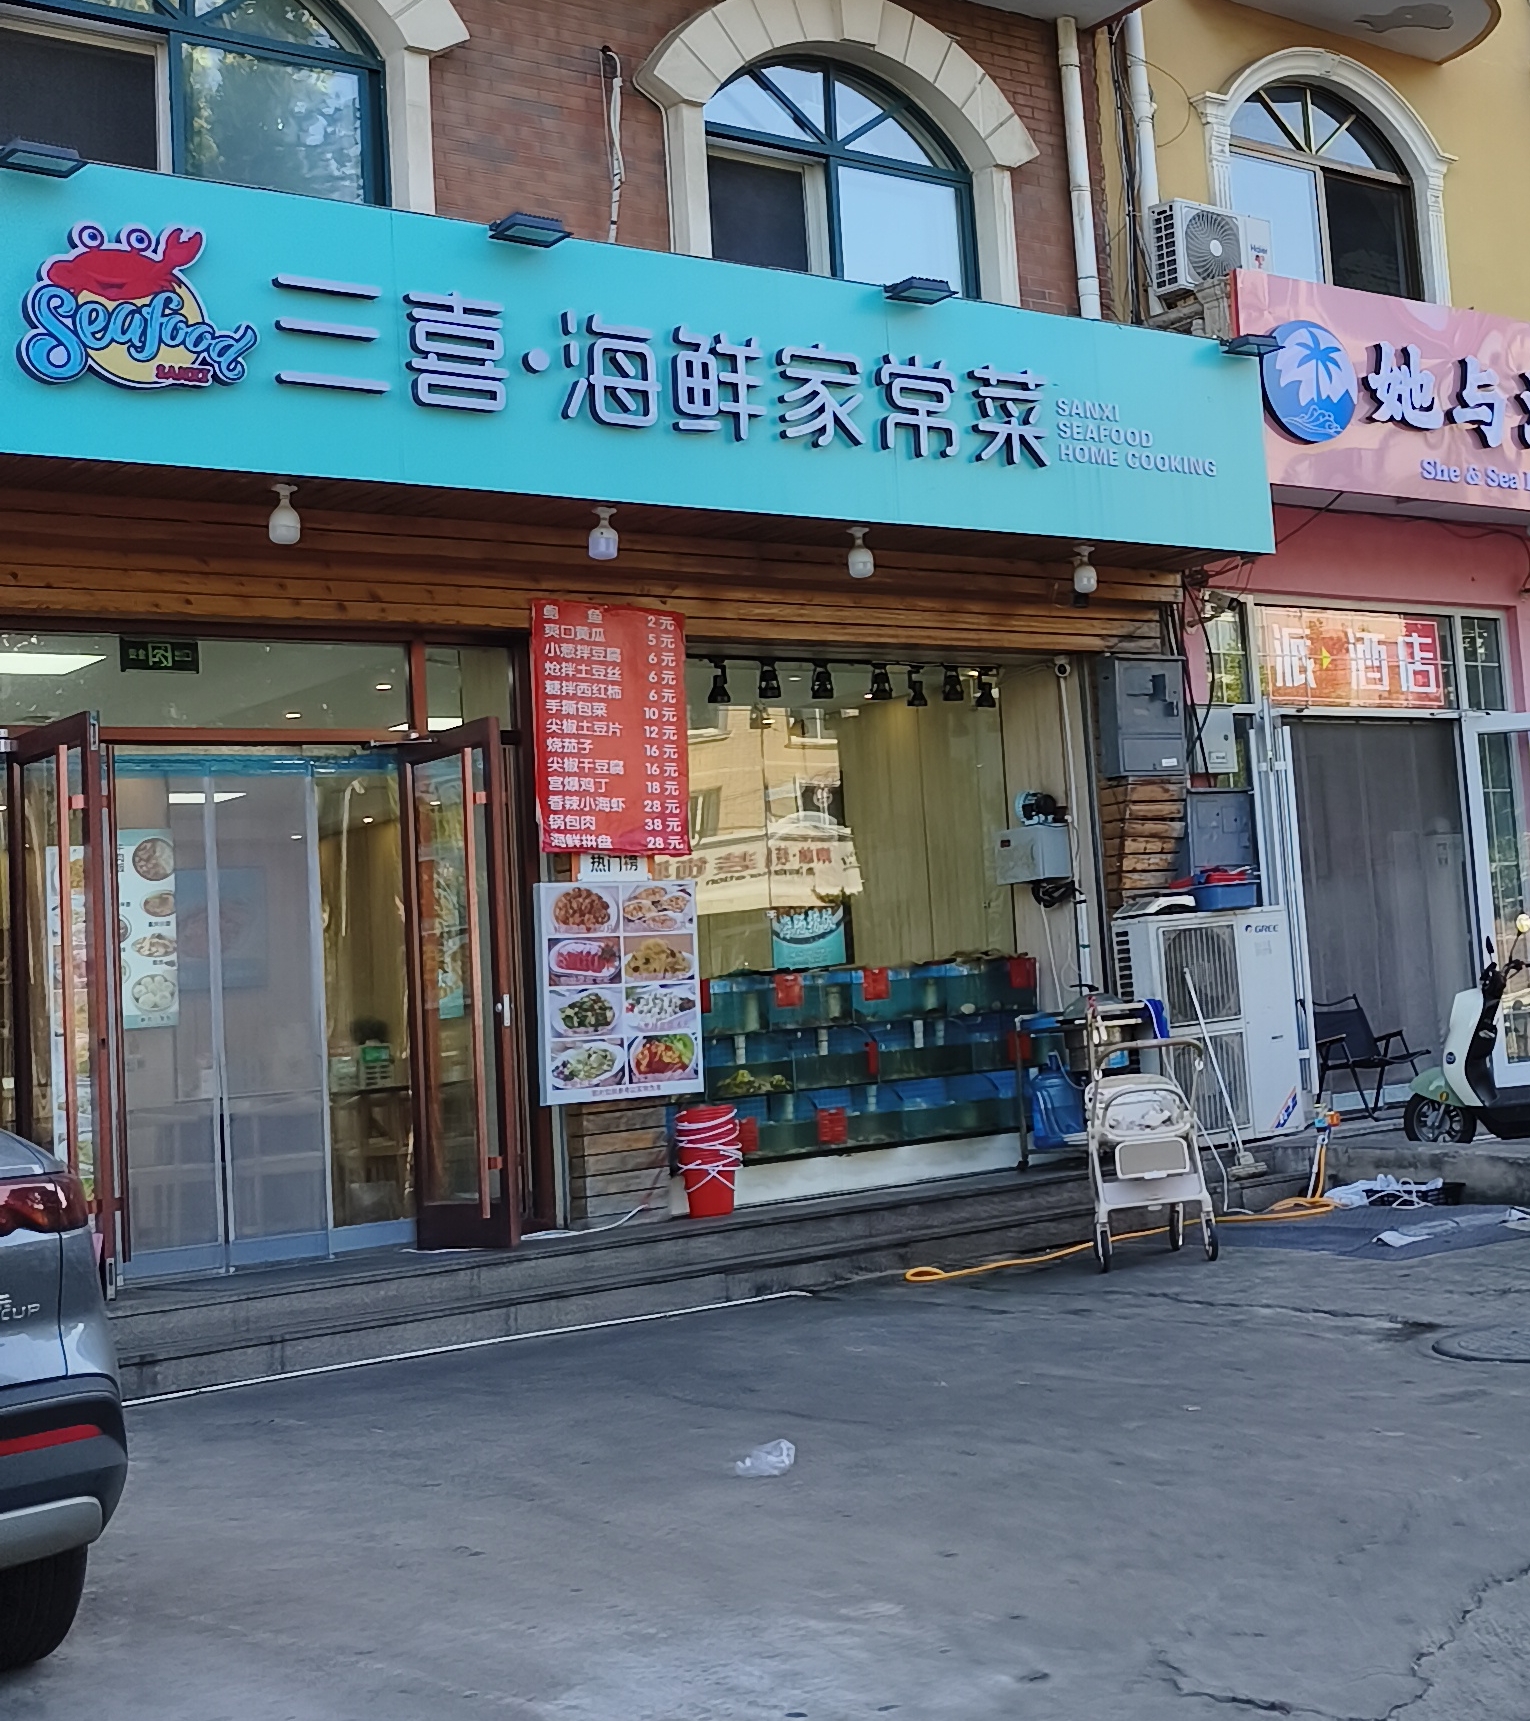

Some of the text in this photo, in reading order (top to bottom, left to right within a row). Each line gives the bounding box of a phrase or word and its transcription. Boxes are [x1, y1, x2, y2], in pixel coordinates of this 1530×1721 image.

[20, 284, 257, 383] Seafood
[272, 275, 1051, 467] 三喜·海鲜家常菜
[1056, 397, 1120, 423] SANXI
[1057, 421, 1154, 449] SEAFOOD
[1058, 444, 1218, 477] HOME COOKING
[1421, 458, 1460, 483] She
[1486, 467, 1518, 490] Sea
[647, 616, 675, 631] 2元
[543, 623, 676, 649] 爽口黄瓜 5元
[544, 643, 677, 667] 小葱拌豆腐 6元
[544, 661, 677, 685] 炝拌土豆丝 6元
[544, 680, 677, 703] 糖拌西红柿 6元
[545, 699, 678, 722] 手撕包菜 10元
[546, 719, 678, 740] 尖椒土豆片 12元
[546, 738, 678, 759] 烧茄子 16元
[547, 757, 679, 777] 尖椒干豆腐 16元
[548, 776, 680, 796] 宫爆鸡丁 18元
[548, 795, 681, 814] 香辣小海虾 28元
[548, 815, 682, 832] 锅包肉 38元
[646, 835, 684, 849] 28元
[590, 854, 638, 873] 热门榜
